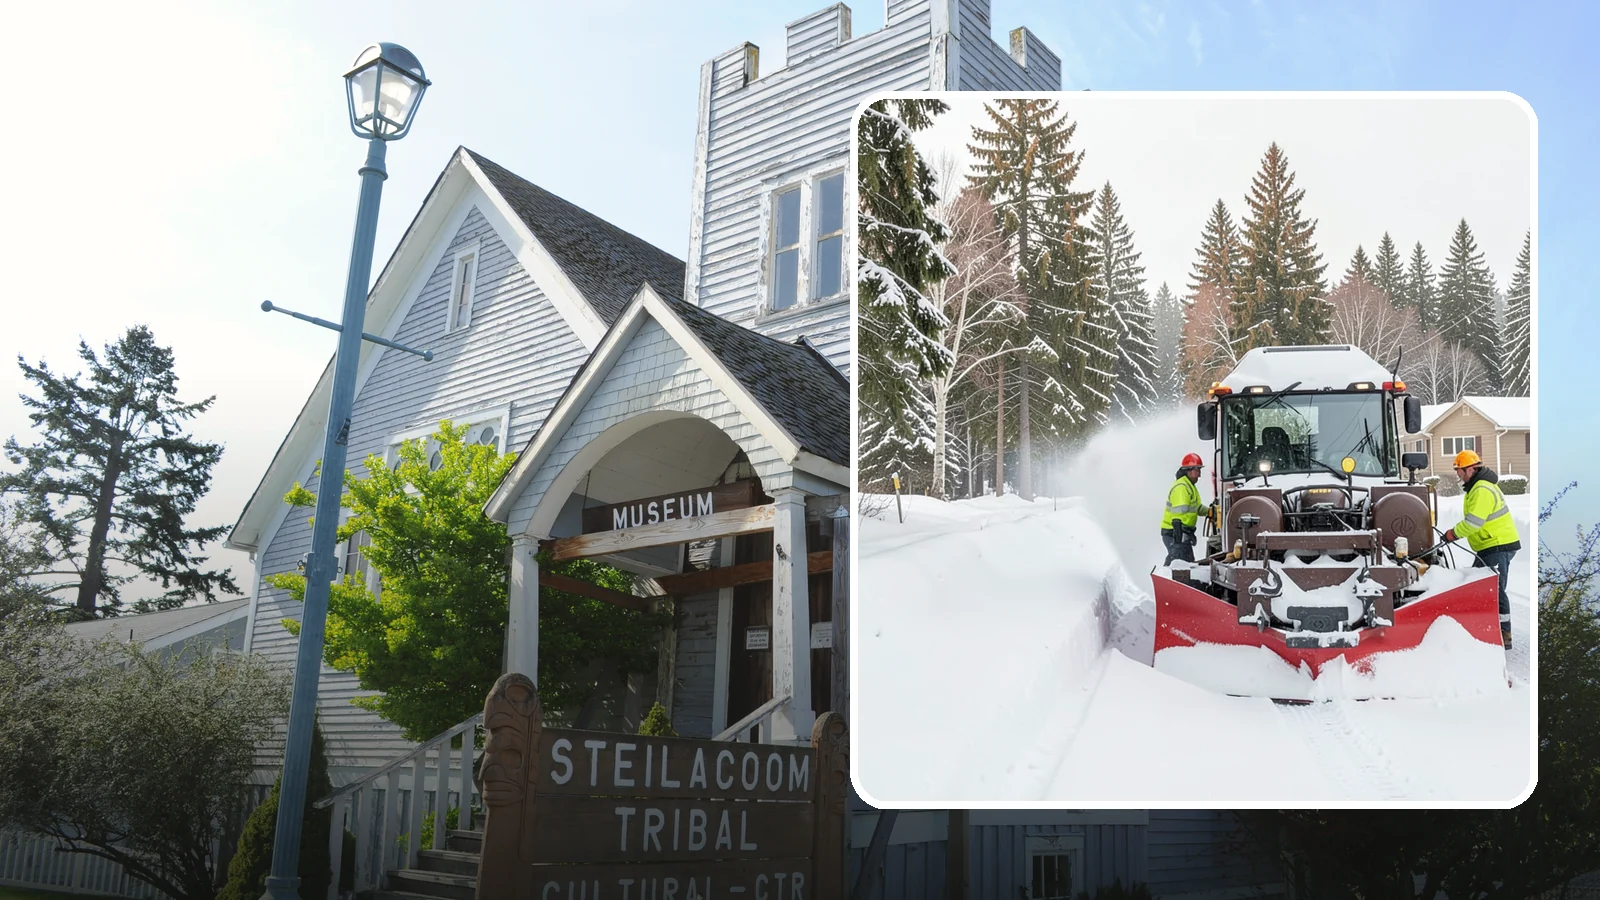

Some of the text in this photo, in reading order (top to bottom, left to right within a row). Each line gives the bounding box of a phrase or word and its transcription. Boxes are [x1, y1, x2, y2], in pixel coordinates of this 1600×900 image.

[612, 491, 714, 531] MUSEUM
[551, 738, 810, 793] STEILACOOM
[615, 806, 758, 852] TRIBAL
